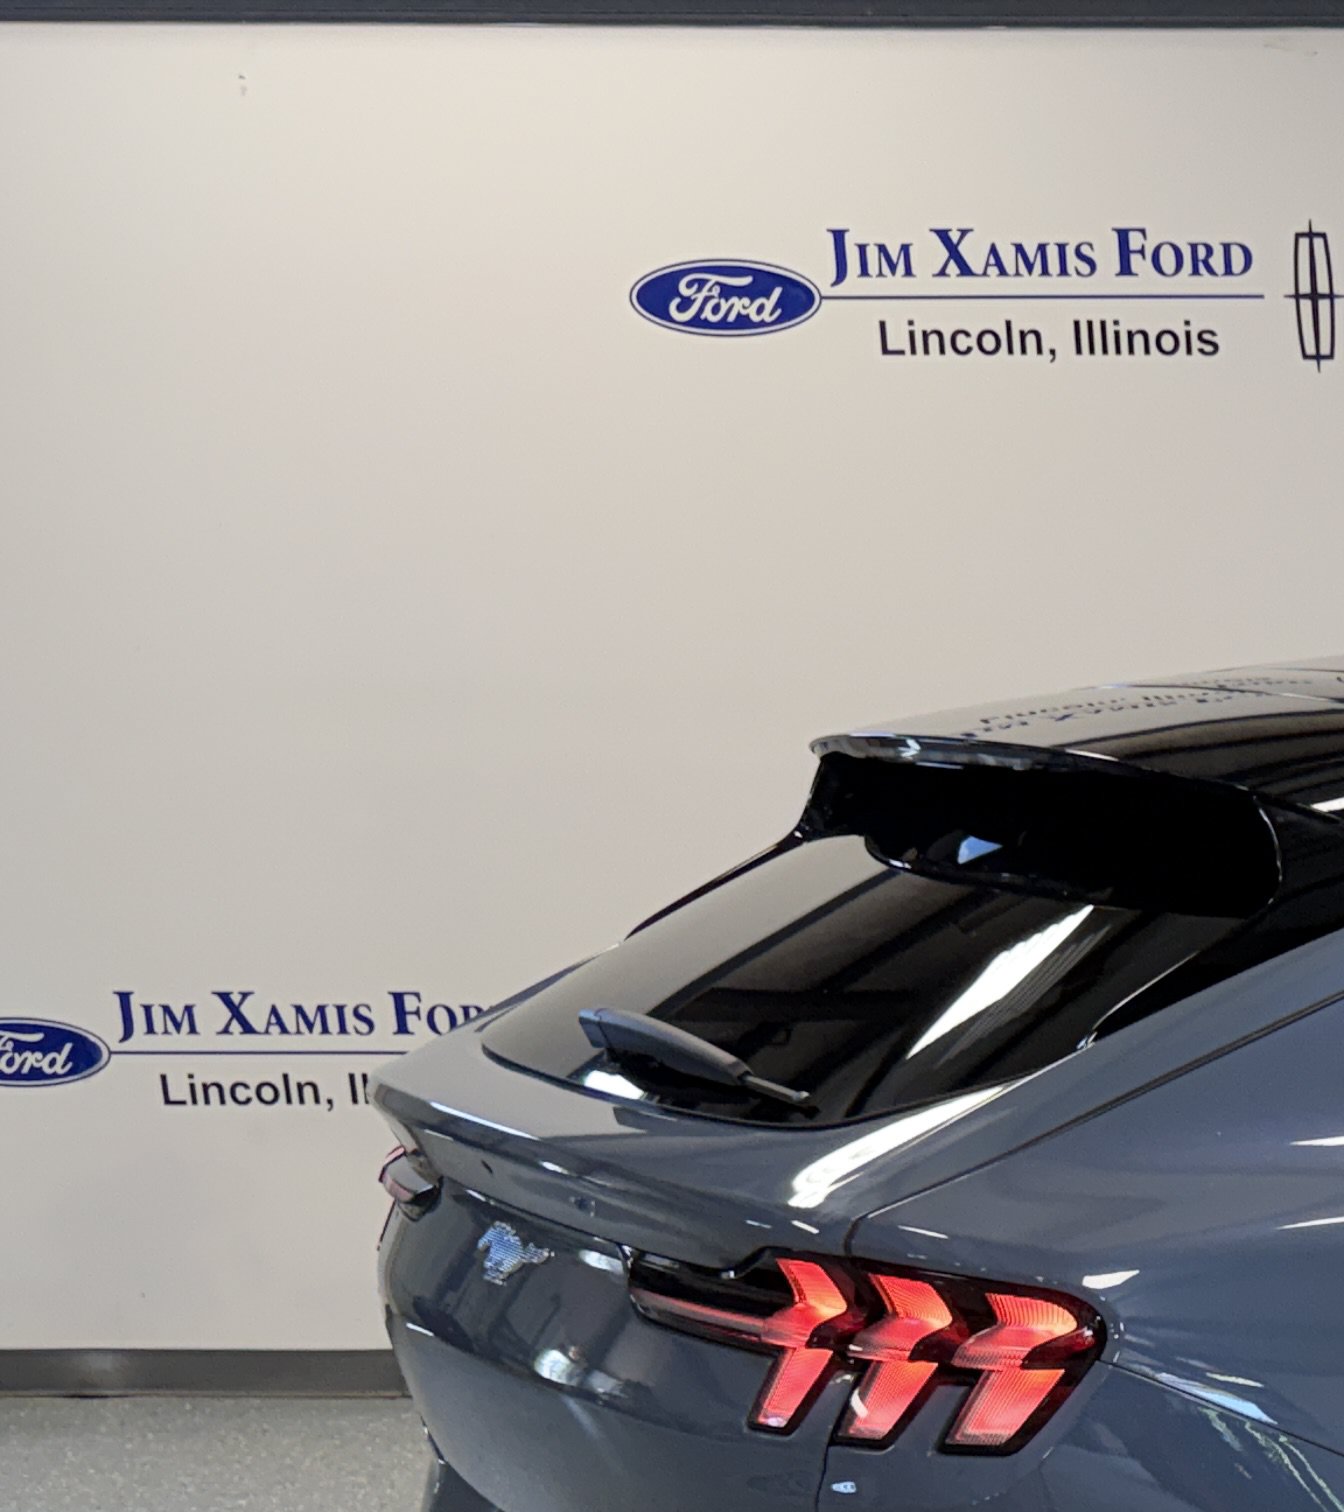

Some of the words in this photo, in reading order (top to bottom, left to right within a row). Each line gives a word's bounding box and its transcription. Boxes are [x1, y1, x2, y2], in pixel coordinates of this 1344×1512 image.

[827, 229, 915, 287] JIM
[929, 229, 1097, 278] XAMIS
[1112, 228, 1253, 277] FORD
[879, 320, 1057, 363] Lincoln,
[1073, 320, 1220, 356] Illinois
[113, 991, 199, 1043] JIM
[211, 991, 375, 1035] XAMIS
[160, 1073, 334, 1111] Lincoln,
